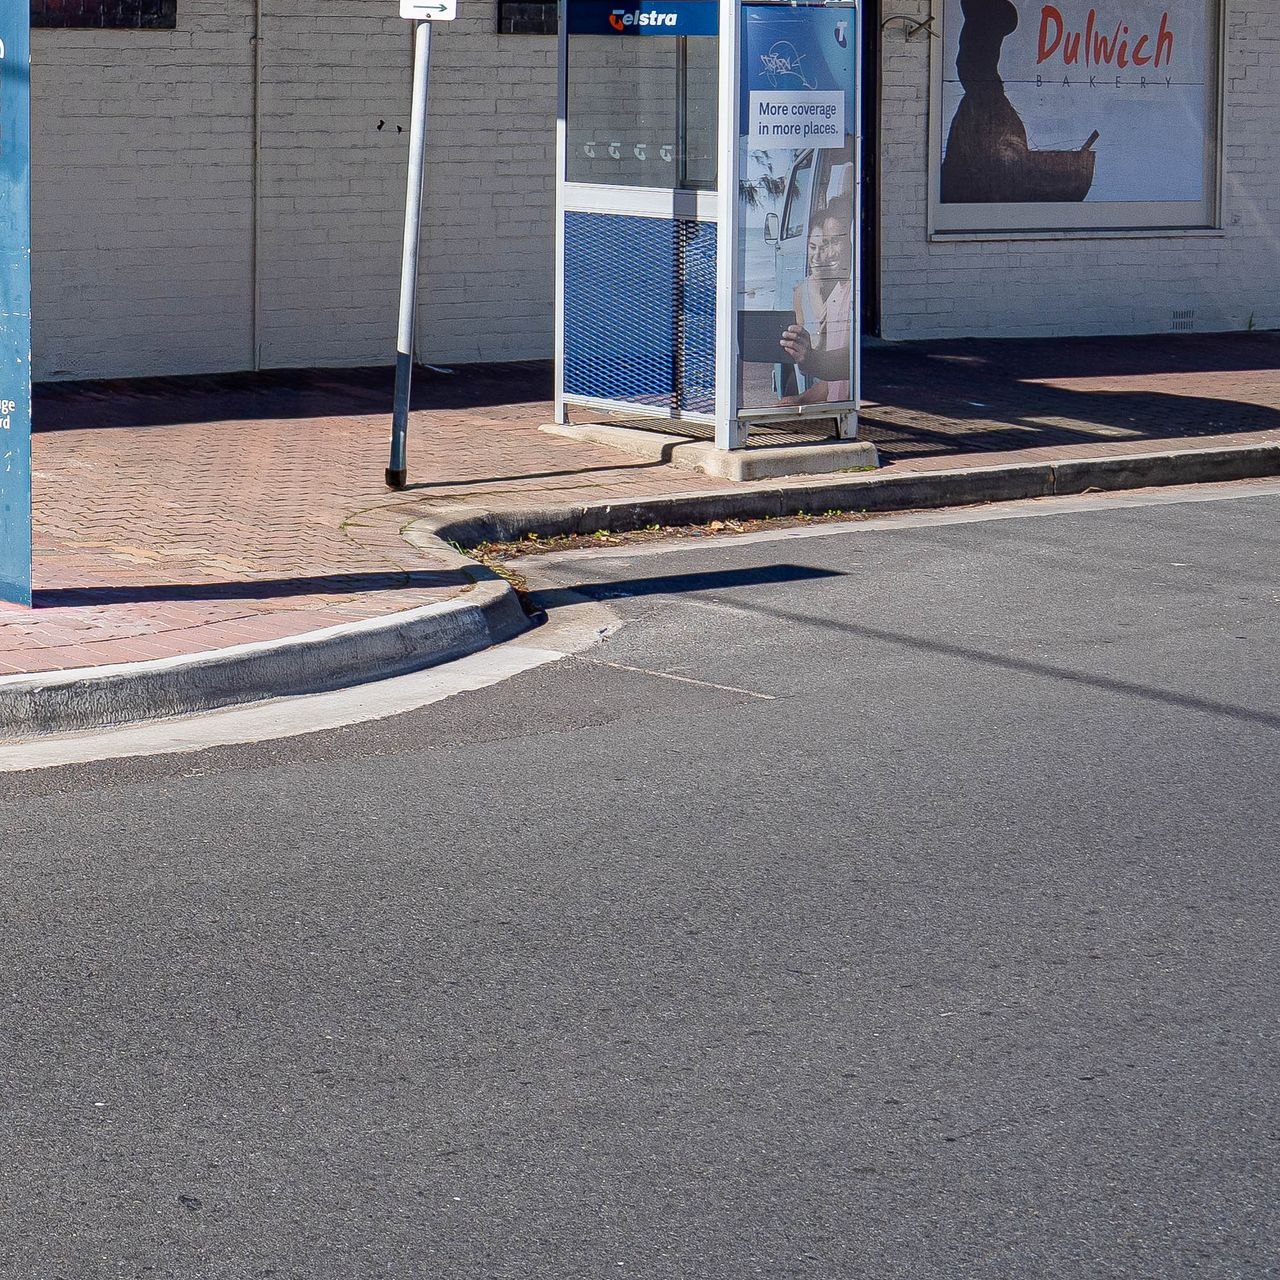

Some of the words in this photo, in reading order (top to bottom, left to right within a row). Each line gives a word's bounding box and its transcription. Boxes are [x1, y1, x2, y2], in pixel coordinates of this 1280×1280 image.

[609, 9, 678, 32] Telstra
[1036, 4, 1174, 69] Dulwich
[1036, 74, 1172, 89] BAKERY
[759, 102, 789, 116] More
[791, 104, 837, 119] coverage
[758, 121, 769, 135] in
[772, 124, 801, 136] more
[803, 121, 839, 138] places.
